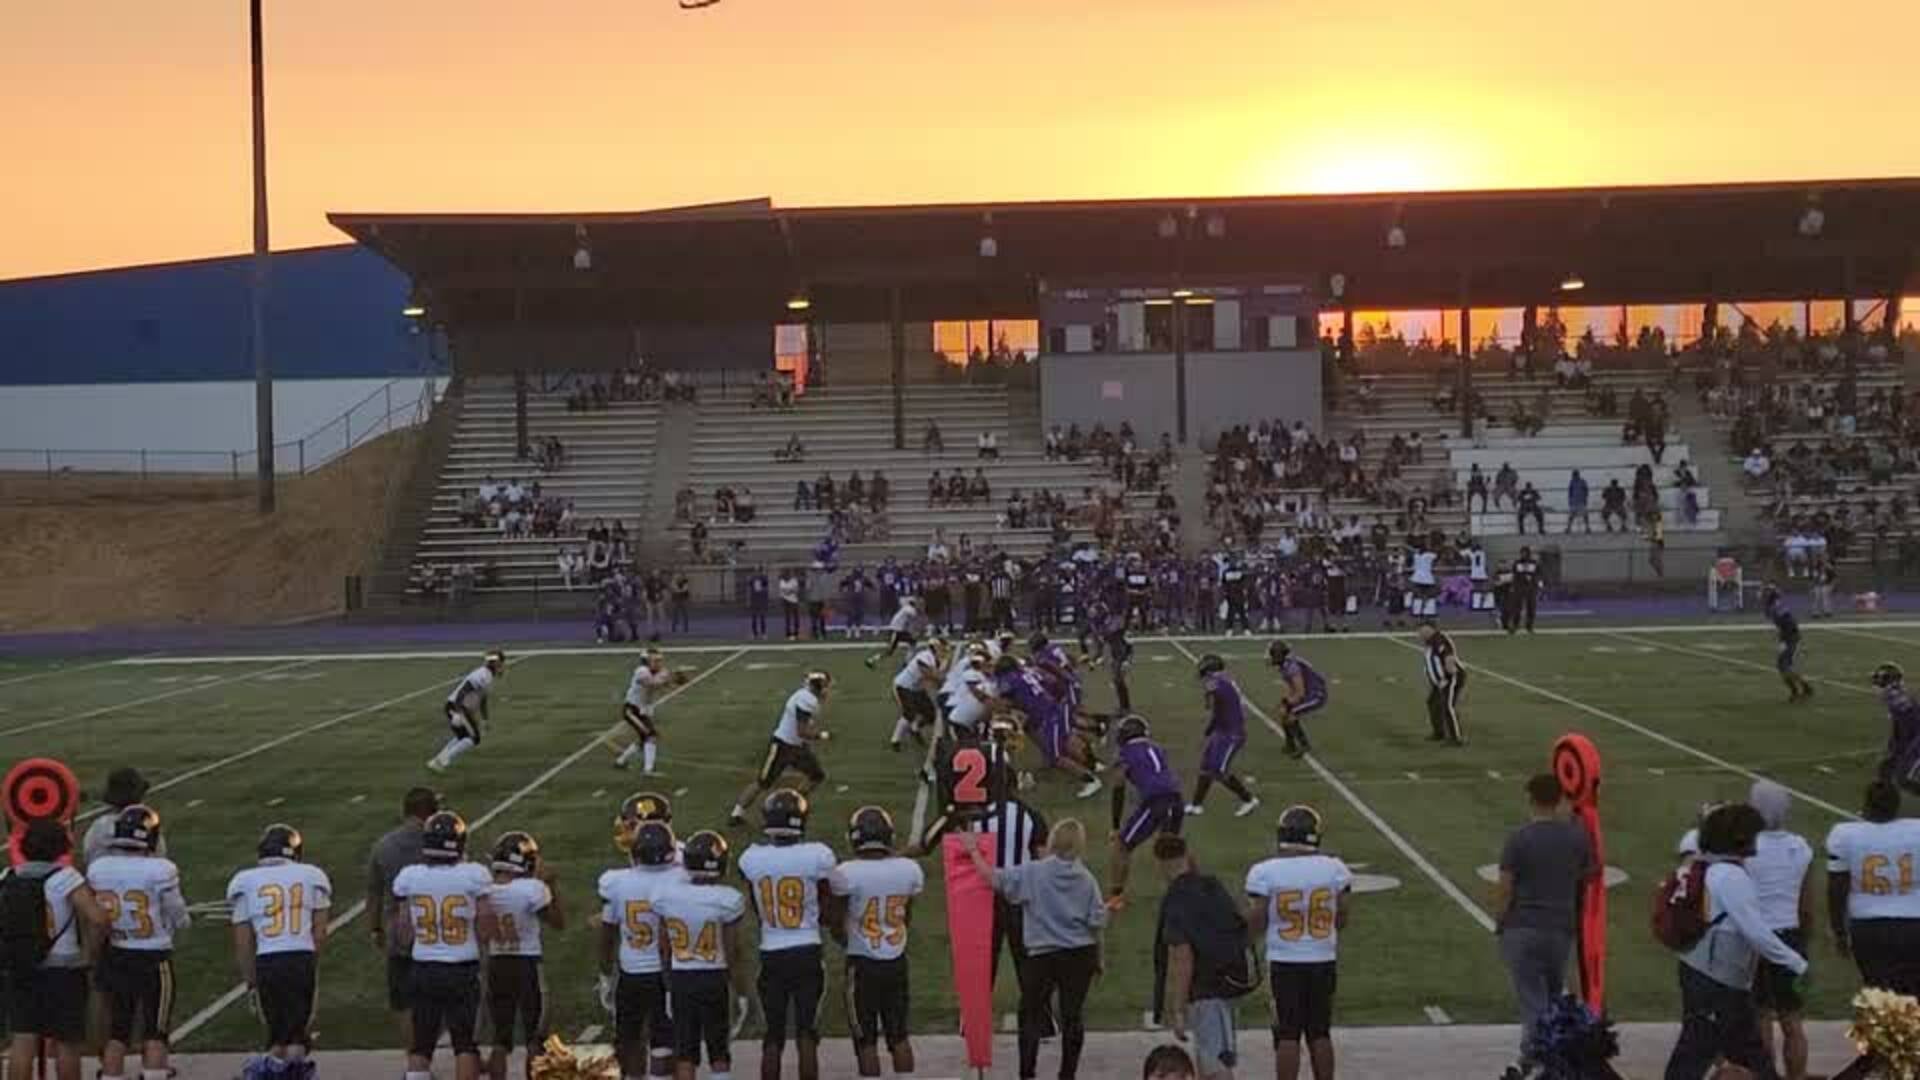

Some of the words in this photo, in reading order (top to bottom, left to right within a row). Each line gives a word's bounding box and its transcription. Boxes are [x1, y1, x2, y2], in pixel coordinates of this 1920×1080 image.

[953, 747, 987, 803] 2
[1147, 746, 1161, 774] 1
[1861, 854, 1912, 896] 61
[257, 882, 304, 937] 31
[414, 895, 469, 945] 36
[759, 875, 805, 929] 18
[861, 896, 909, 949] 45
[1277, 887, 1333, 942] 56
